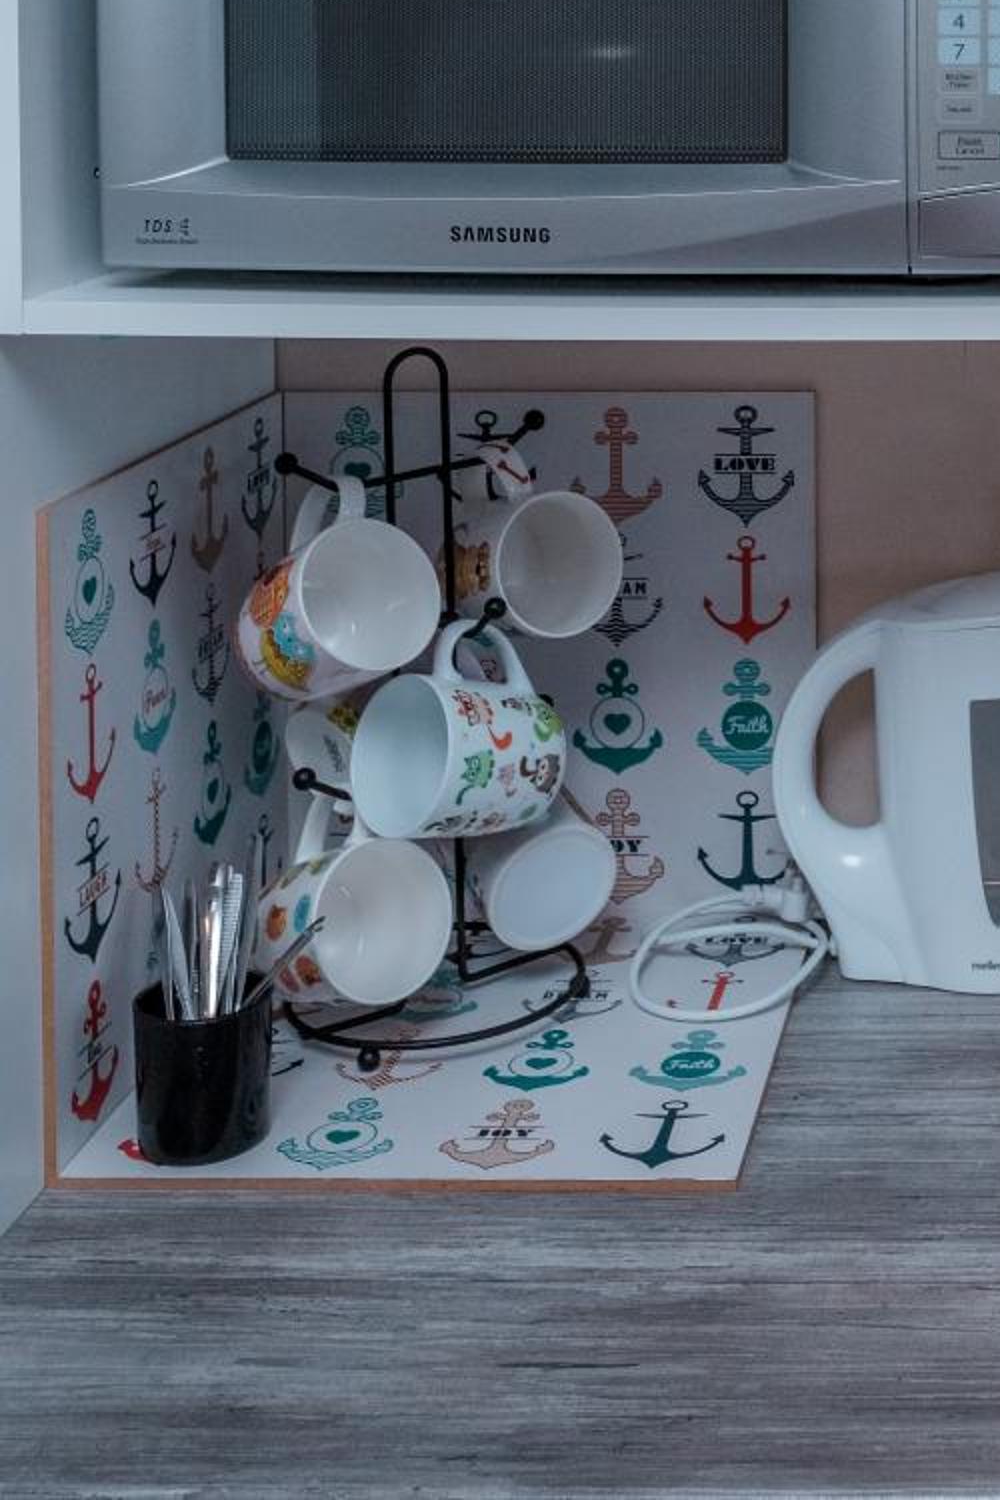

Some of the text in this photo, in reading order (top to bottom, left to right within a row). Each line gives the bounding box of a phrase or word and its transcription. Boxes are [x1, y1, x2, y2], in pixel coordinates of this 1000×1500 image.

[952, 13, 965, 29] 4
[952, 43, 965, 60] 7
[449, 225, 551, 243] SAMSUNG
[714, 457, 776, 471] LOVE
[725, 713, 770, 736] Faith
[610, 839, 641, 853] OY
[664, 1057, 716, 1072] Faith
[478, 1128, 535, 1138] JOY
